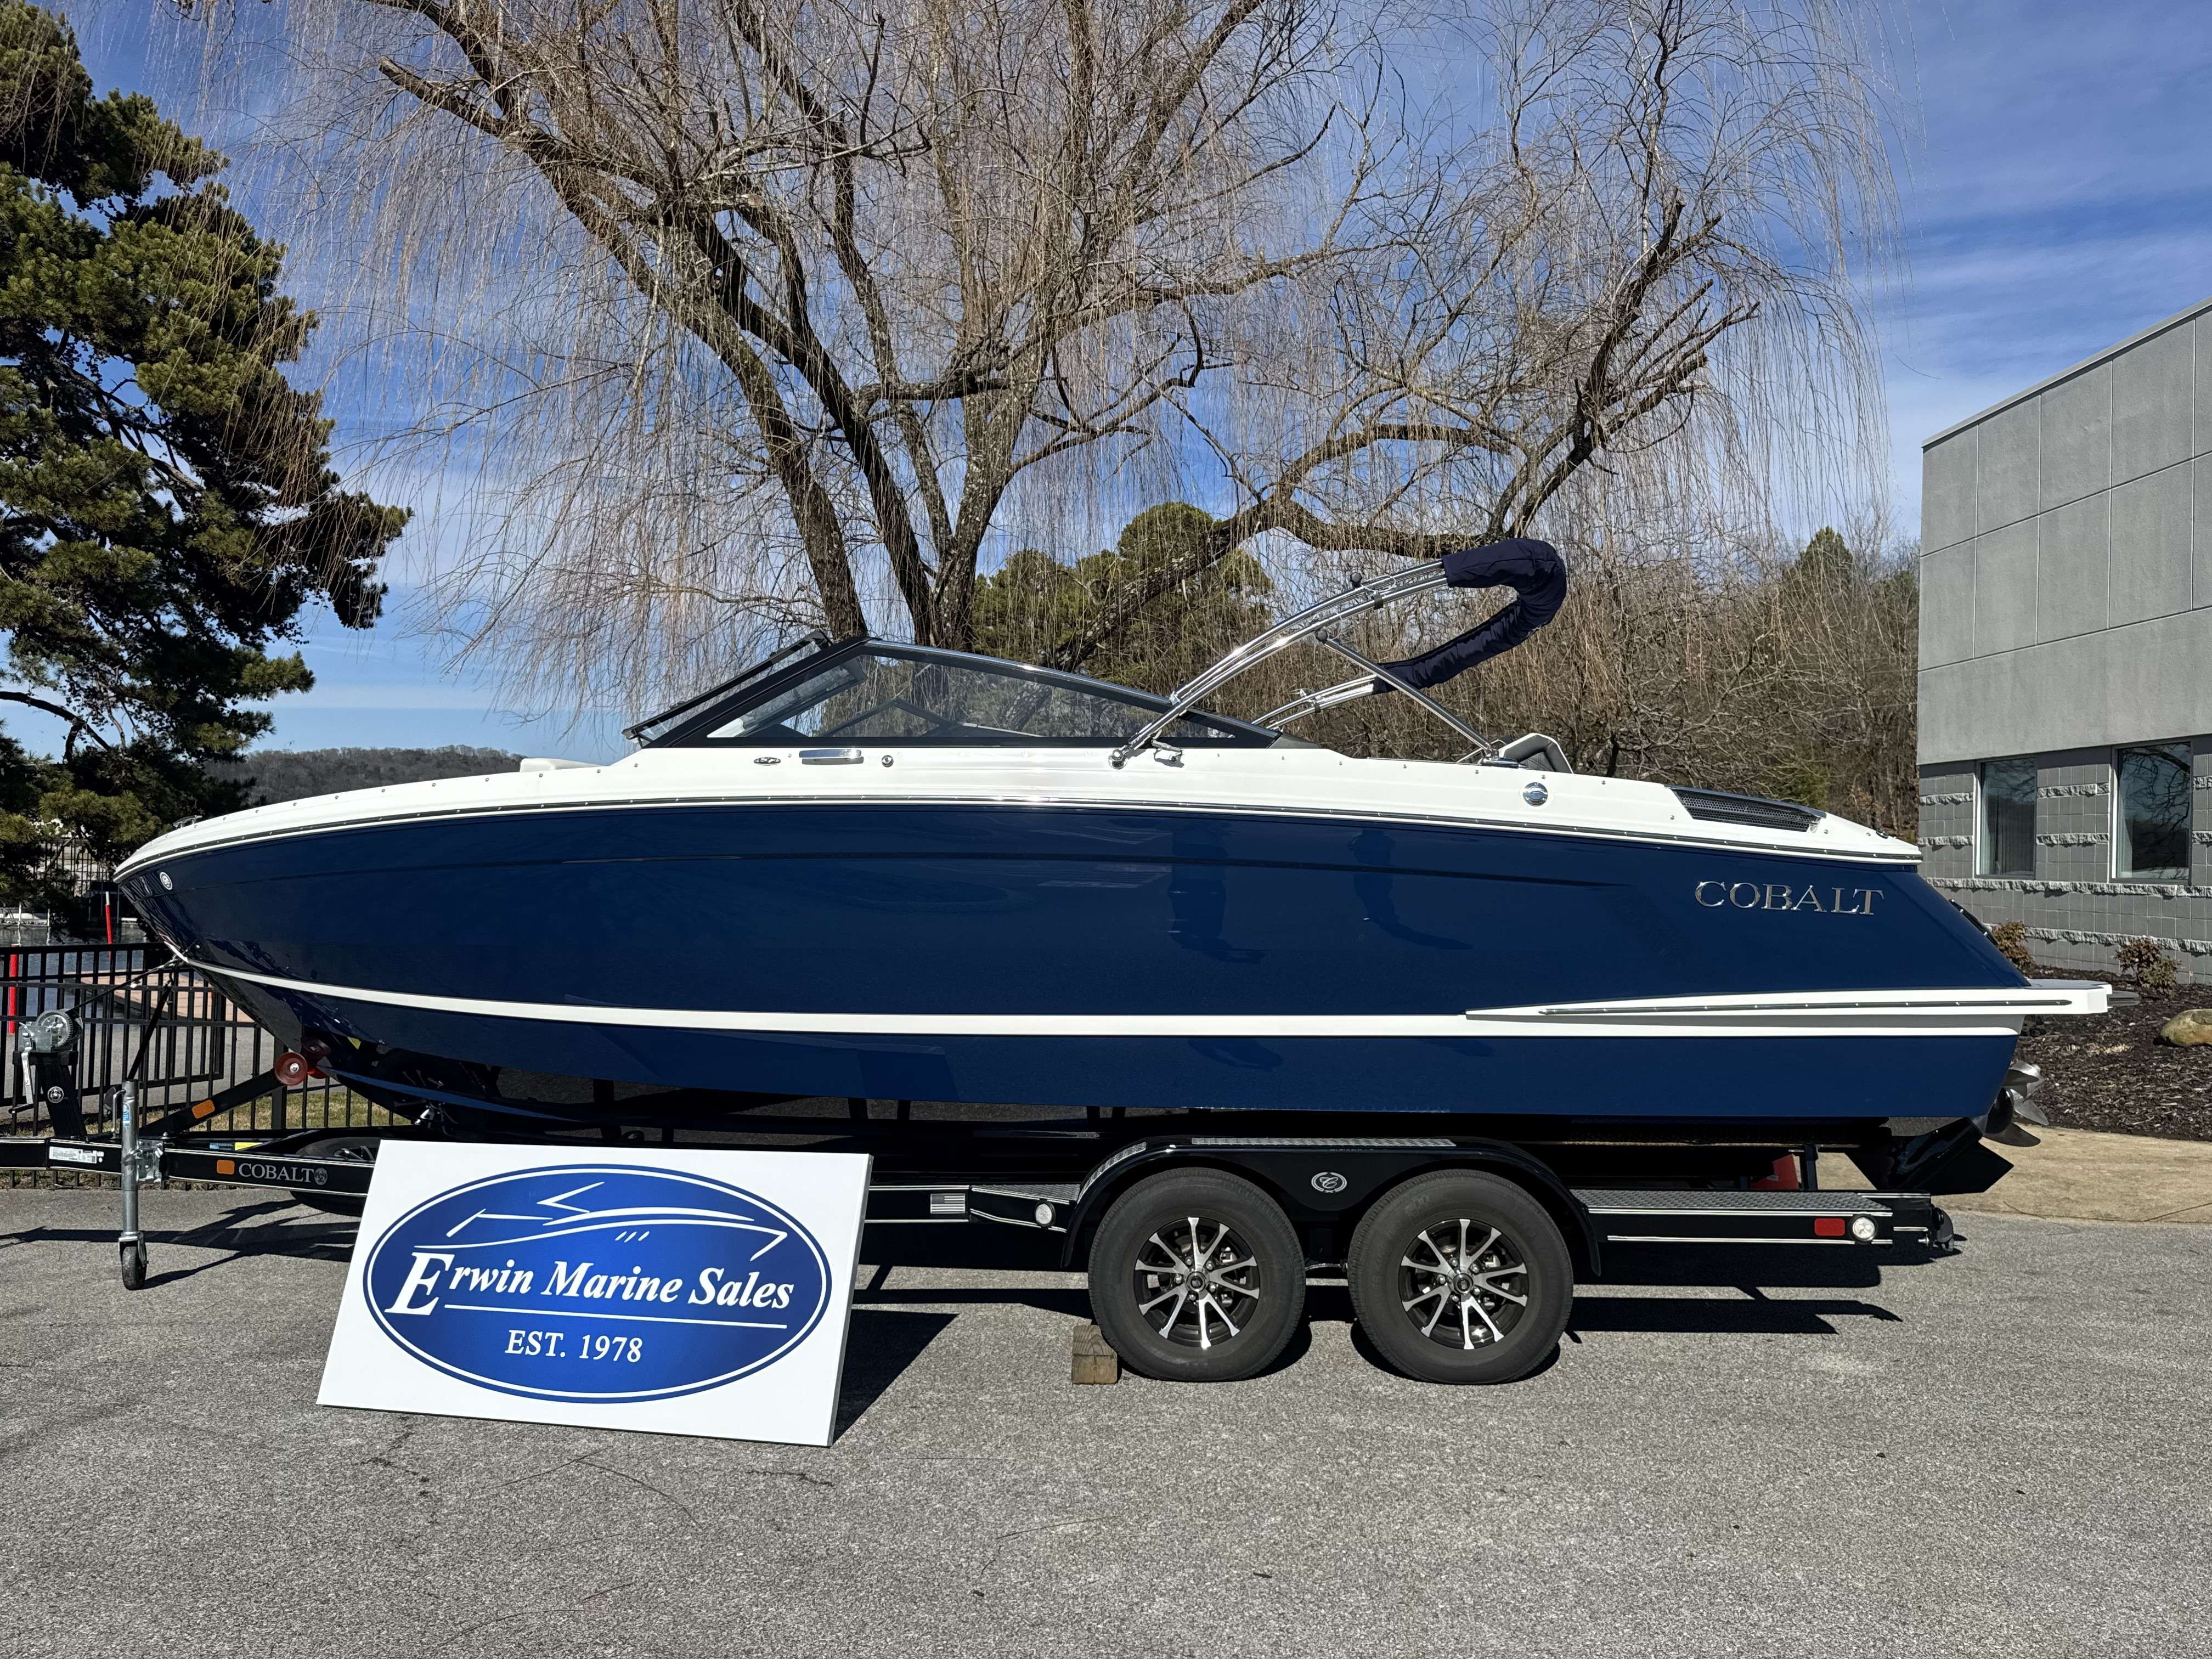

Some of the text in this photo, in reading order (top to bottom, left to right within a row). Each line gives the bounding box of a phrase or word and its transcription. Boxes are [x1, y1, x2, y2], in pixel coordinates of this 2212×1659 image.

[1695, 880, 1884, 915] COBALT
[238, 1163, 314, 1183] COBALT
[384, 1252, 794, 1316] Erwin Marine Sales
[504, 1329, 642, 1363] EST. 1978
